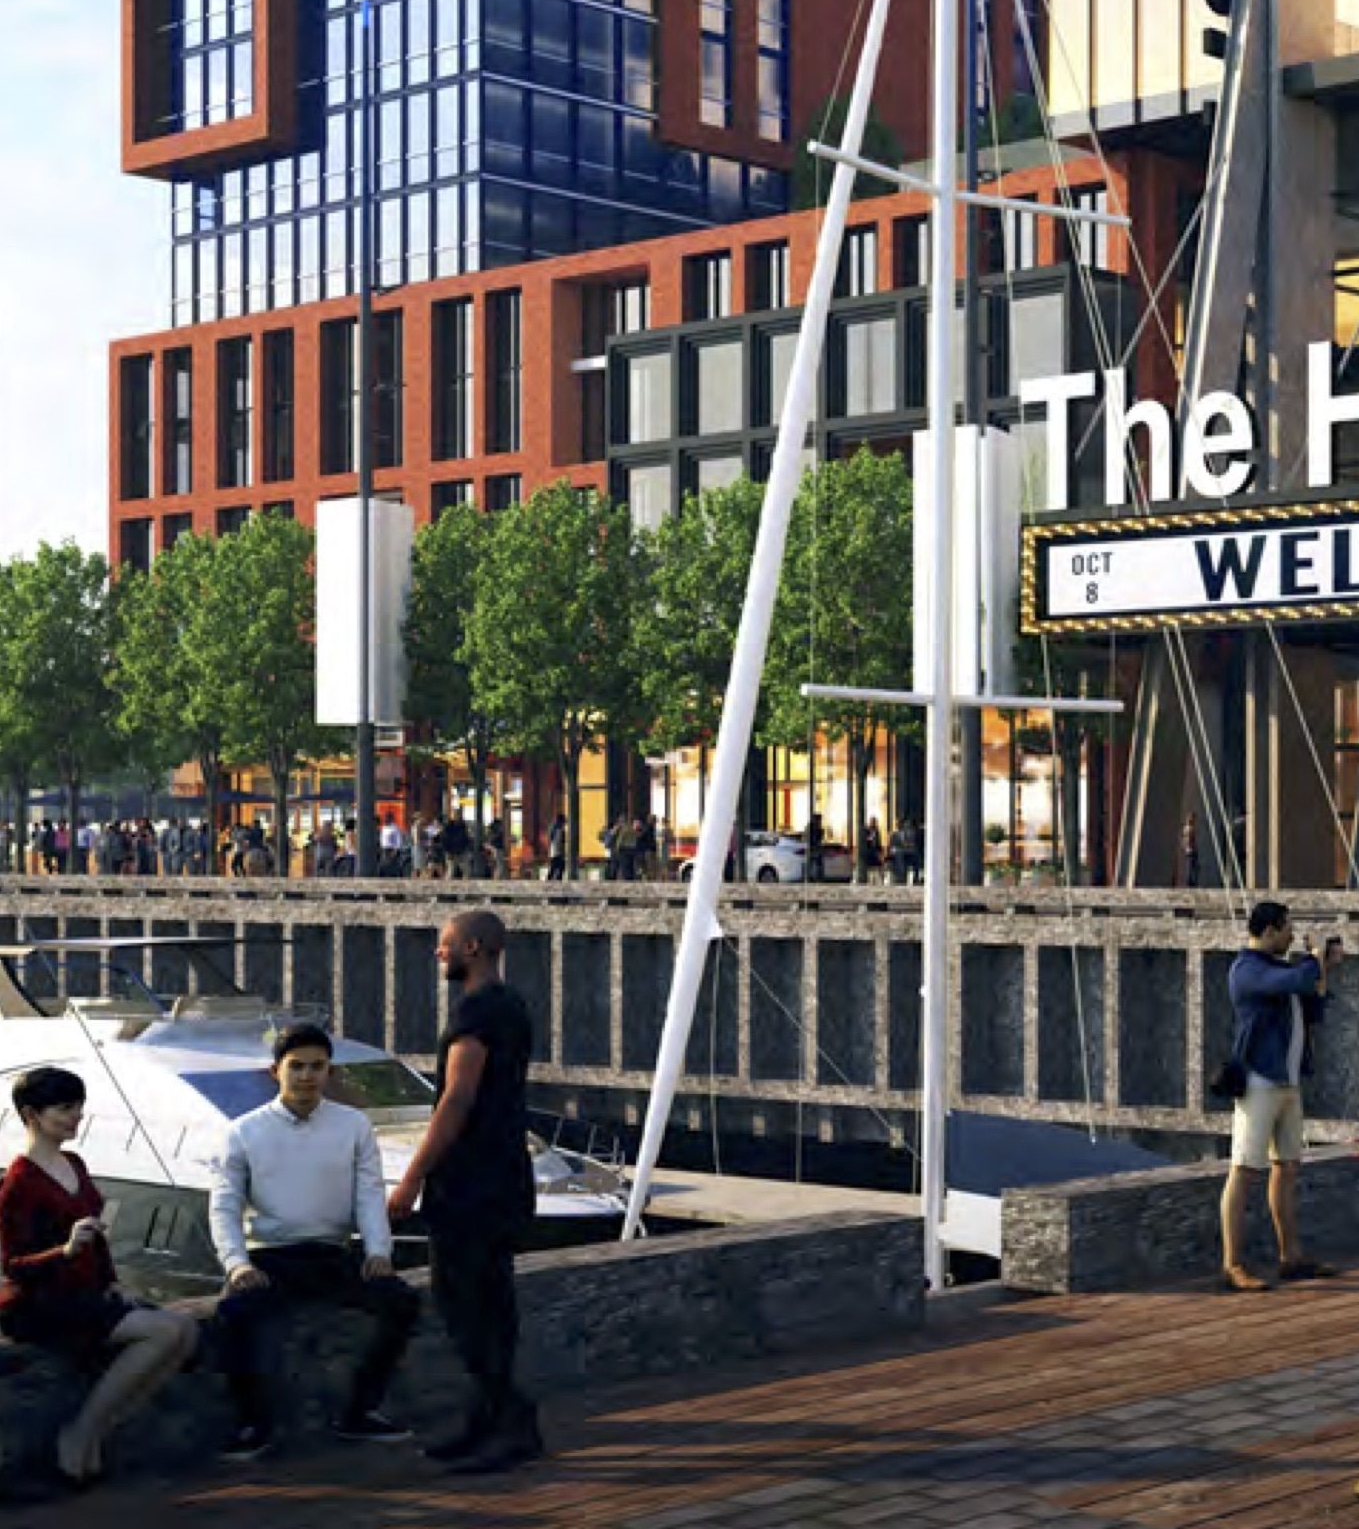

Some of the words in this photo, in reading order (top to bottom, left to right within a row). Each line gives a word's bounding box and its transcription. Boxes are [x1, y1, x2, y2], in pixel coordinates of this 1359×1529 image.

[1020, 368, 1254, 510] The
[1071, 551, 1113, 576] OCT
[1085, 581, 1099, 604] 8
